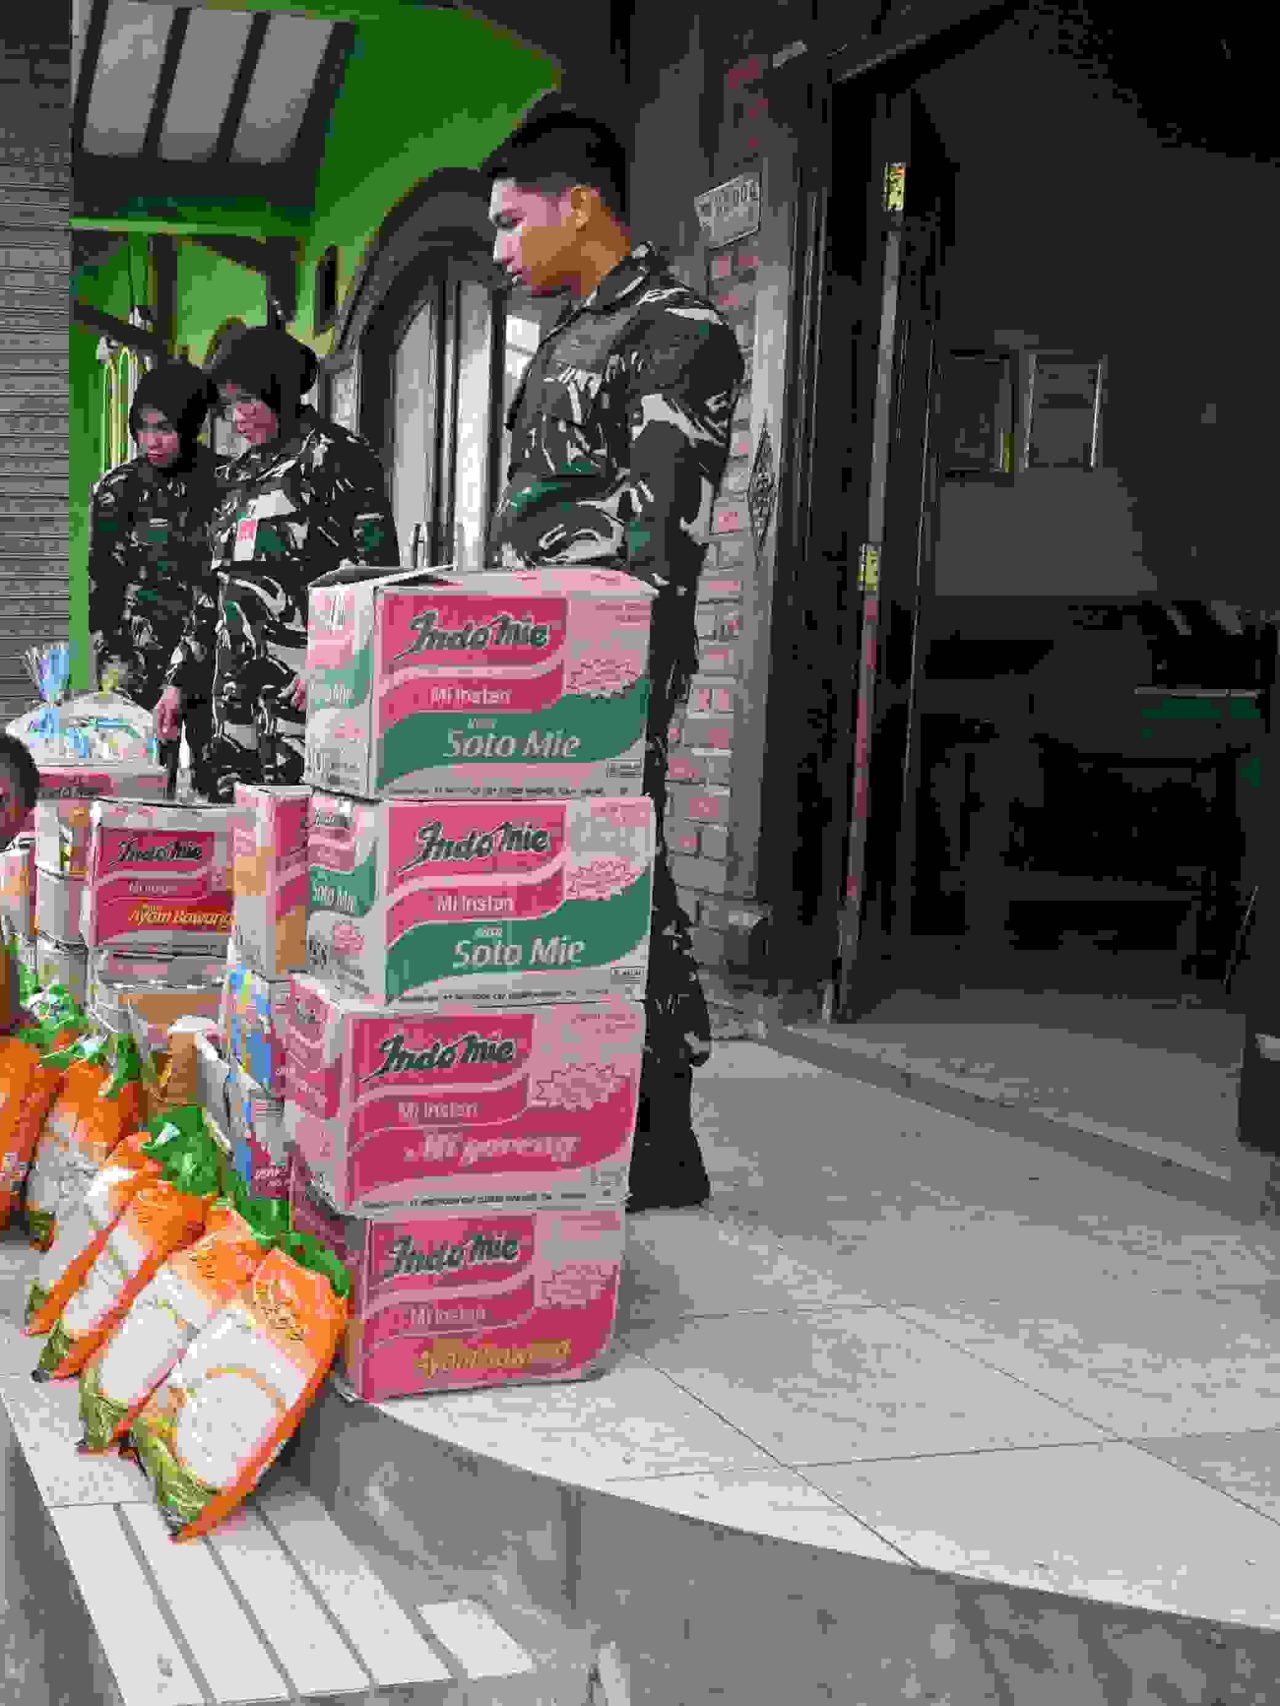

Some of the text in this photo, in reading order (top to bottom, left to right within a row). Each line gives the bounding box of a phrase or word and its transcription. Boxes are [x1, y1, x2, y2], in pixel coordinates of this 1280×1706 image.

[444, 729, 582, 758] Soto Mie
[437, 896, 459, 913] Mi
[452, 934, 586, 970] Soto Mie
